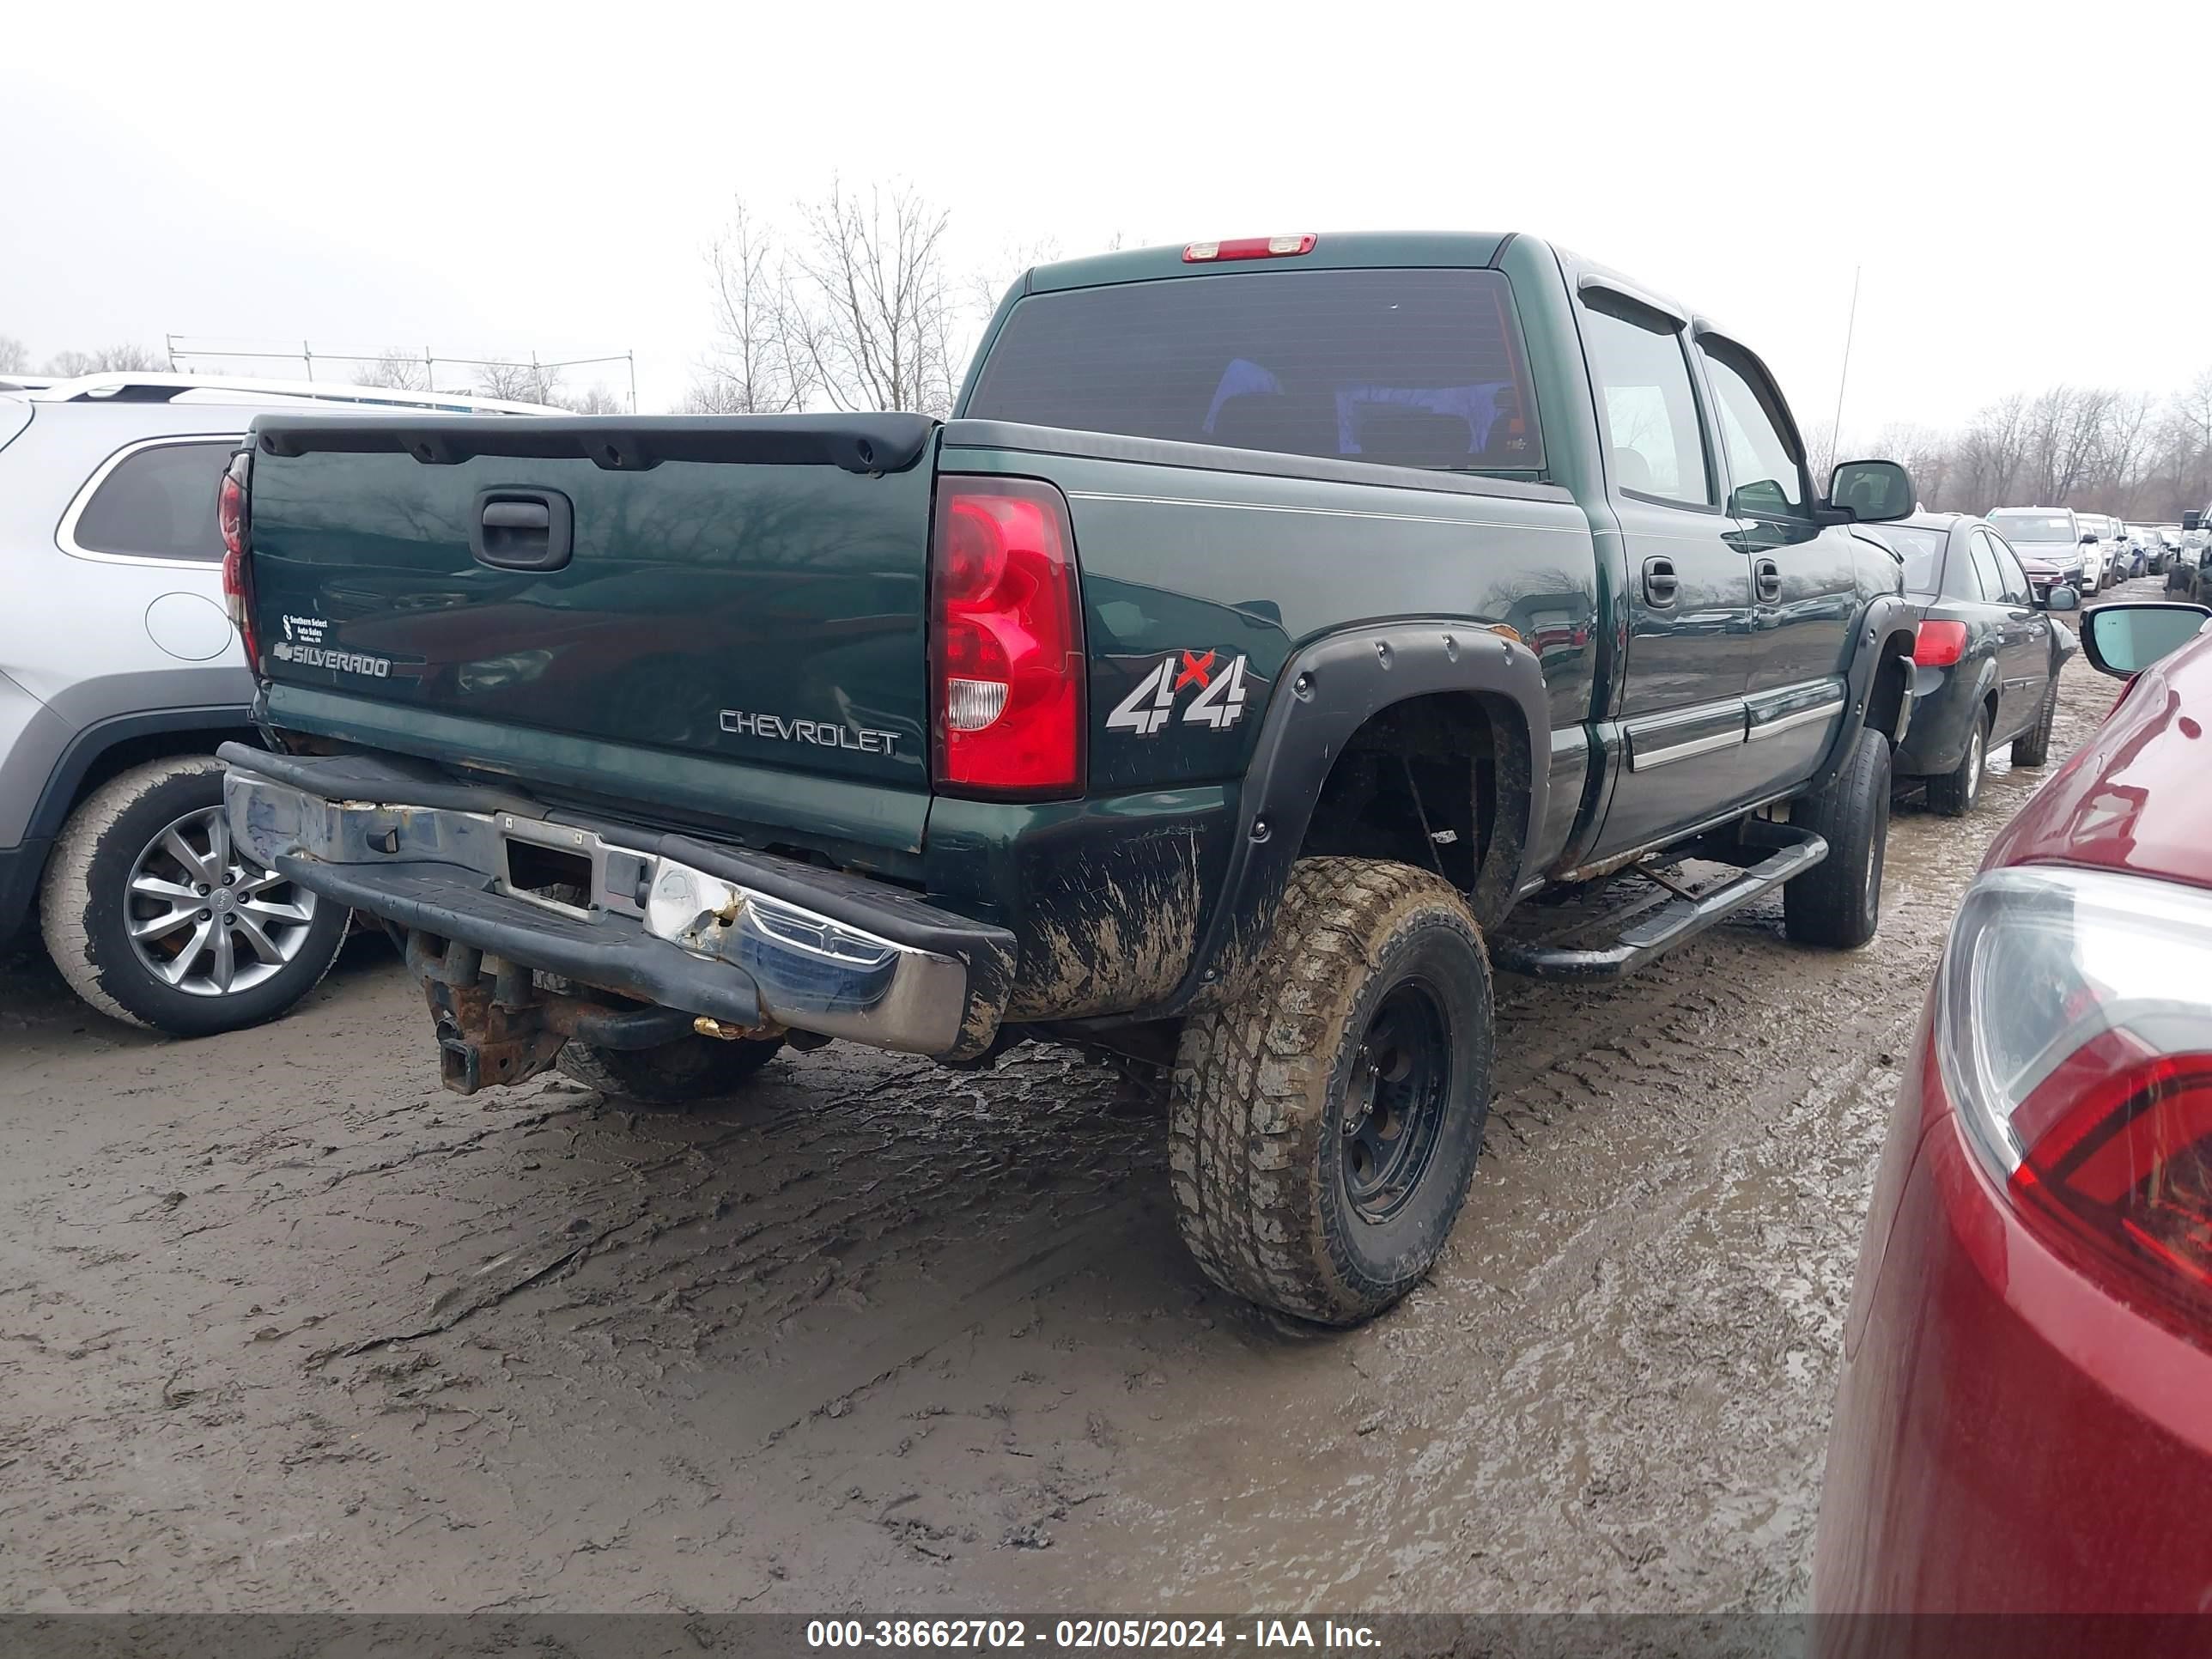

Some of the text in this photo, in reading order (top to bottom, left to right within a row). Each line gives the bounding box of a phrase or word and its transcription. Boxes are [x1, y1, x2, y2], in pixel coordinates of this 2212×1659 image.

[289, 615, 328, 628] Southern Select
[297, 625, 323, 637] Auto Sales
[293, 645, 391, 679] SILVERADO
[719, 708, 902, 756] CHEVROLET
